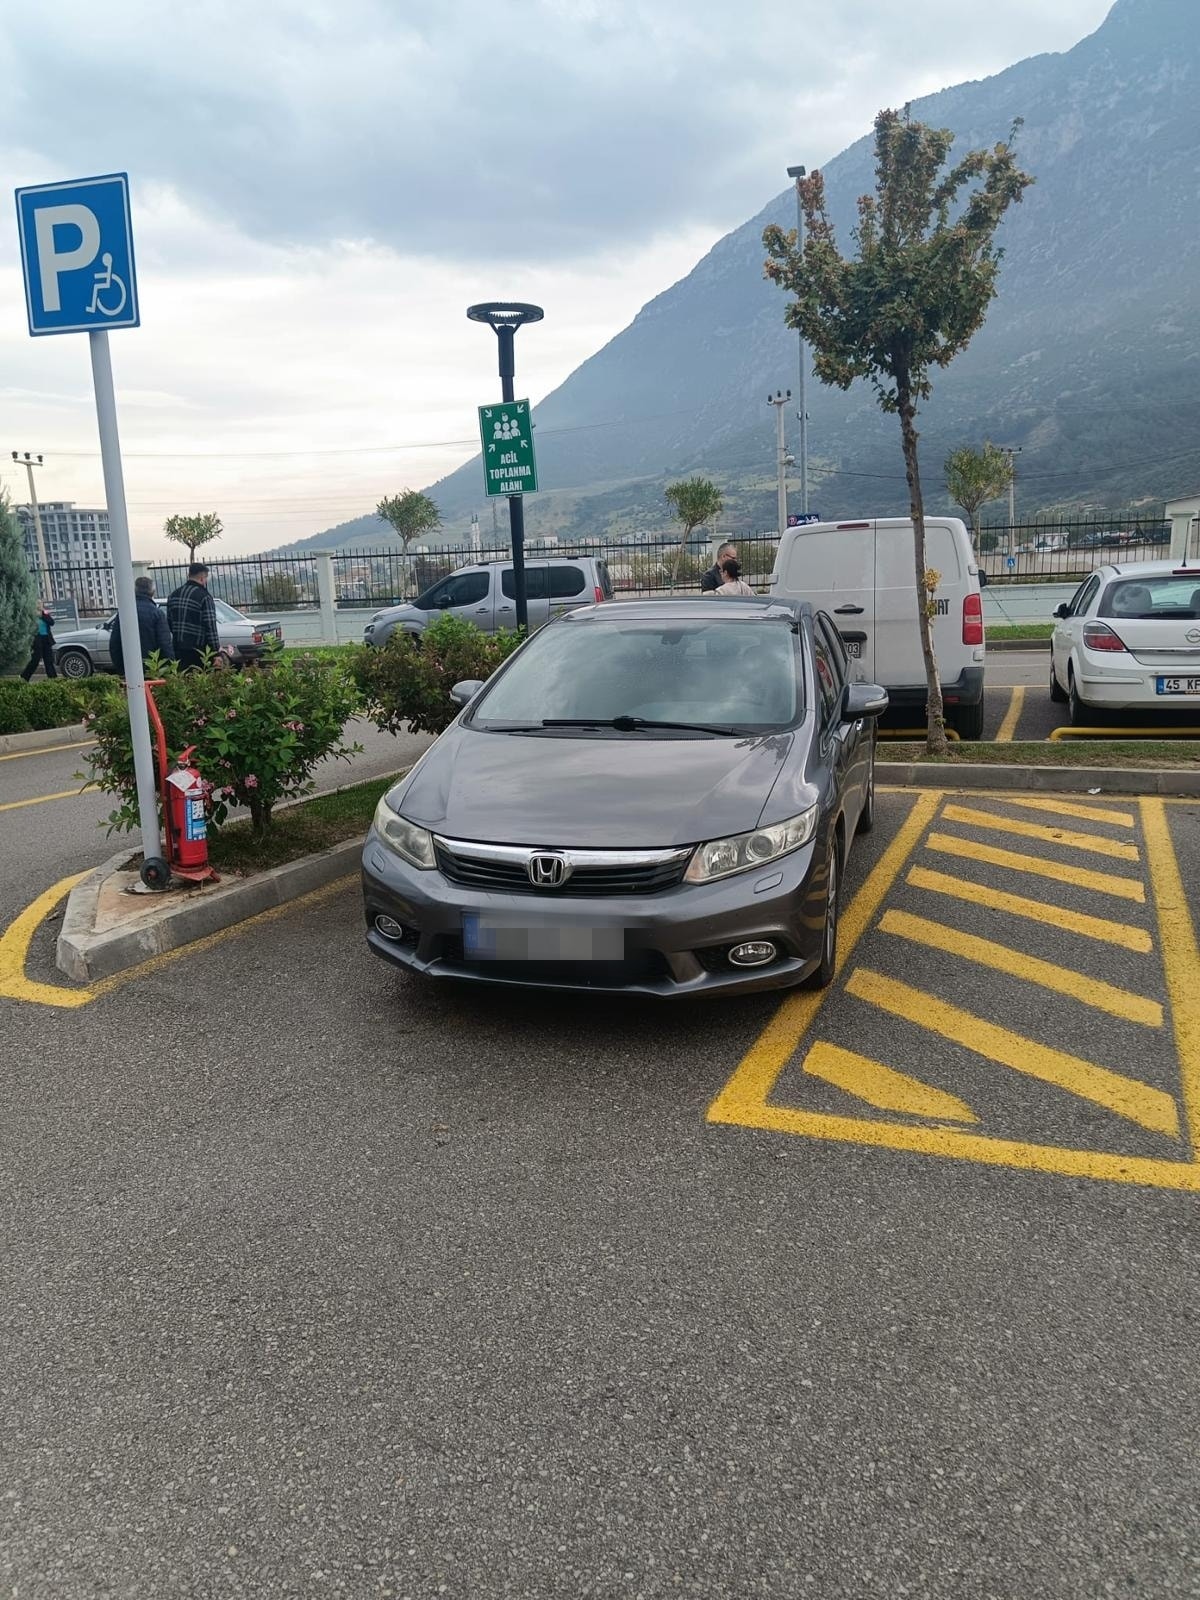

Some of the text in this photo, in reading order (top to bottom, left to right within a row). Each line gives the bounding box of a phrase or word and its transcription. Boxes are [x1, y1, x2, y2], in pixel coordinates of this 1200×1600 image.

[34, 204, 101, 312] P
[500, 451, 518, 464] ACİL
[489, 466, 531, 480] TOPLANMA
[500, 480, 522, 492] ALANI
[1166, 680, 1180, 690] 45
